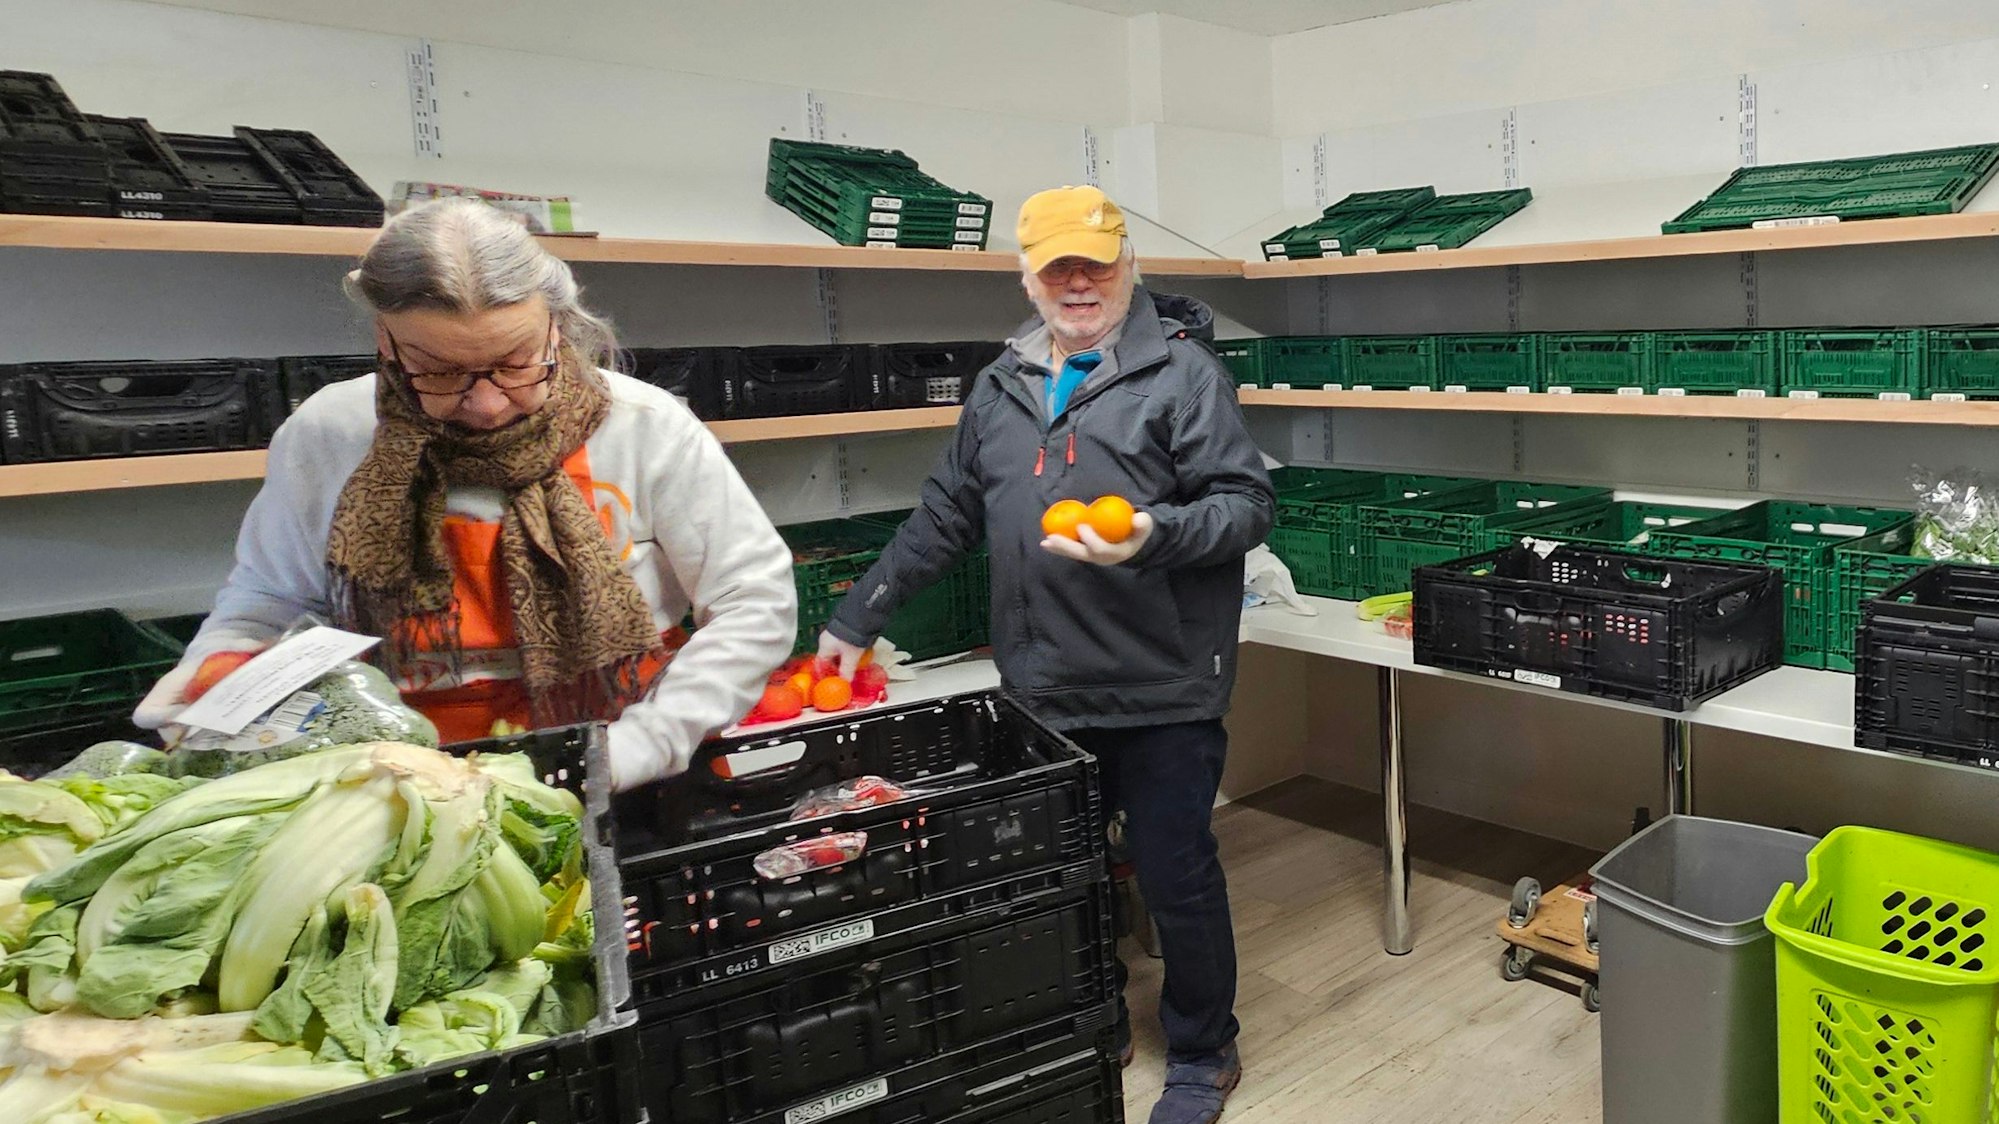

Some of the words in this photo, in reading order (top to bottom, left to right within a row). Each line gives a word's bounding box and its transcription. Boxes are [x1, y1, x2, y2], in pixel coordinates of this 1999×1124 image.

[815, 928, 850, 945] IFCO
[702, 969, 719, 982] LL
[726, 958, 759, 975] 6413
[830, 1088, 865, 1107] IFCO
